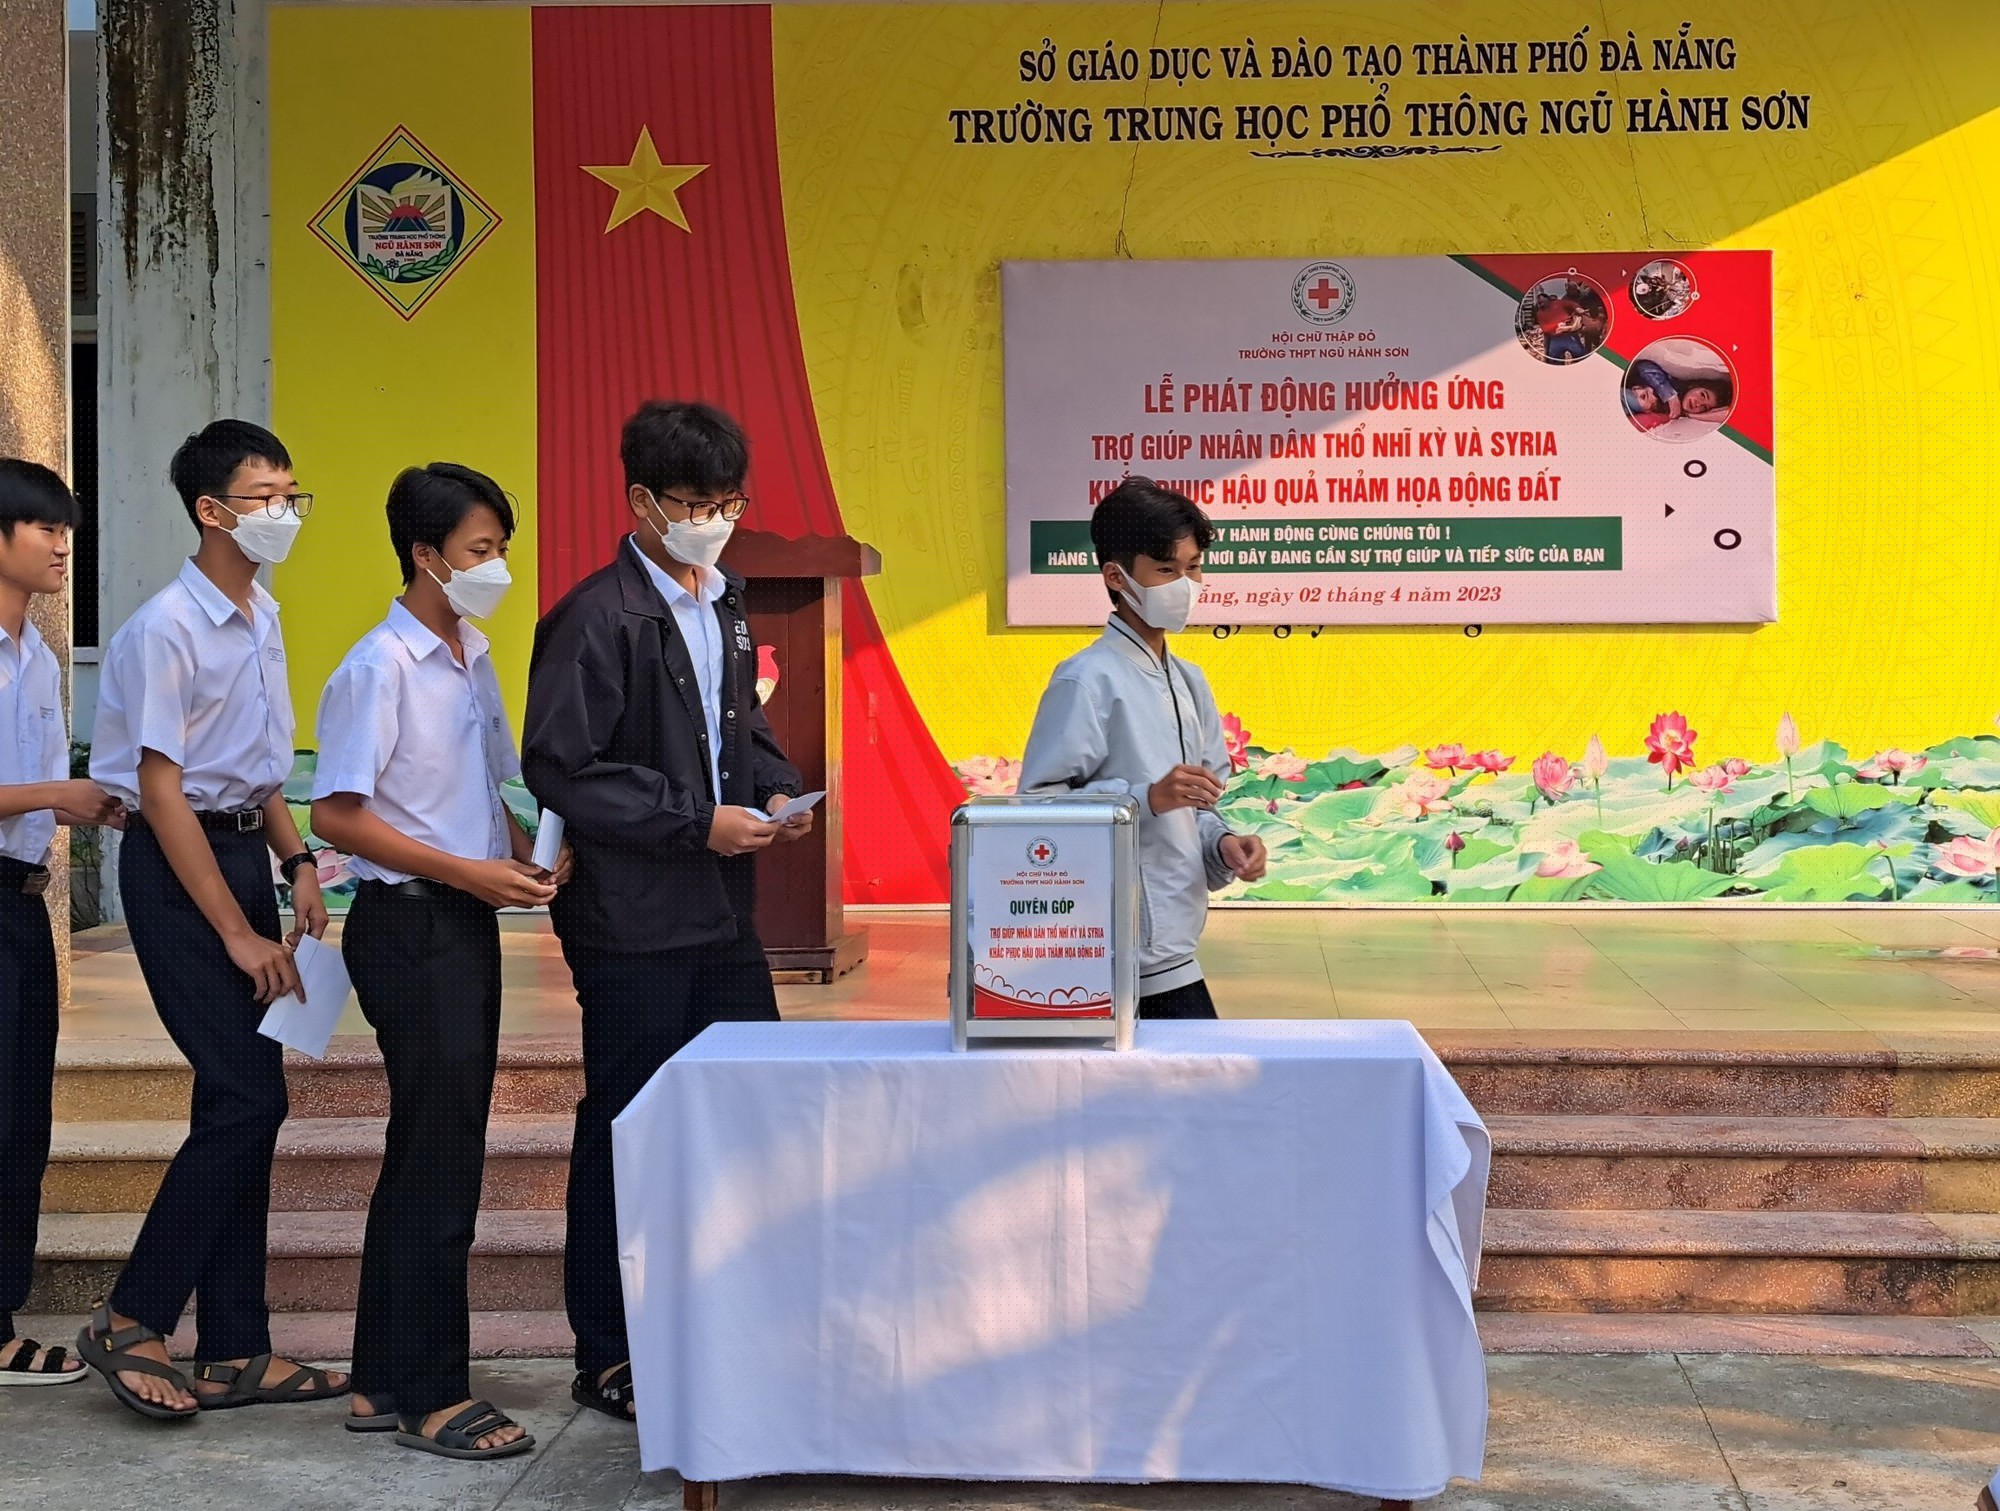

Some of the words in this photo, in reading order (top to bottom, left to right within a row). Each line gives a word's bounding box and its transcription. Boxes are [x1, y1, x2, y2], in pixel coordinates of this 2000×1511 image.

[1019, 38, 1057, 82] SỞ
[1068, 40, 1139, 81] GIÁO
[1149, 47, 1211, 87] DỤC
[1220, 37, 1262, 78] VÀ
[1271, 37, 1332, 78] ĐÀO
[1343, 44, 1402, 84] TẠO
[1412, 34, 1518, 75] THÀNH
[1528, 25, 1590, 74] PHỐ
[1600, 30, 1643, 72] ĐÀ
[1653, 22, 1737, 71] NẴNG
[949, 99, 1093, 144] TRƯỜNG
[1104, 106, 1224, 142] TRUNG
[1235, 104, 1309, 147] HỌC
[1321, 83, 1391, 139] PHỔ
[1404, 92, 1528, 137] THÔNG
[1540, 90, 1612, 135] NGŨ
[1626, 88, 1730, 133] HÀNH
[1741, 89, 1811, 131] SƠN
[375, 240, 394, 250] NGŨ
[396, 240, 422, 250] HÀNH
[424, 240, 442, 249] SƠN
[1272, 331, 1293, 345] HỘI
[1297, 331, 1322, 342] CHỮ
[1325, 331, 1355, 345] THẬP
[1358, 329, 1376, 342] ĐỎ
[1239, 347, 1286, 359] TRƯỜNG
[1290, 349, 1316, 358] THPT
[1320, 346, 1345, 358] NGŨ
[1349, 346, 1381, 358] HÀNH
[1384, 347, 1409, 357] SƠN
[1144, 372, 1175, 413] LỄ
[1184, 376, 1252, 413] PHÁT
[1261, 376, 1335, 418] ĐỘNG
[1345, 372, 1438, 411] HƯỞNG
[1448, 377, 1504, 410] ỨNG
[1092, 433, 1134, 465] TRỢ
[1141, 429, 1192, 460] GIÚP
[1200, 429, 1262, 460] NHÂN
[1270, 428, 1316, 459] DÂN
[1323, 422, 1365, 458] THỔ
[1372, 428, 1411, 457] NHĨ
[1419, 426, 1447, 457] KỲ
[1454, 427, 1483, 457] VÀ
[1490, 431, 1557, 457] SYRIA
[1222, 474, 1266, 509] HẬU
[1274, 470, 1319, 506] QUẢ
[1326, 469, 1388, 503] THẢM
[1396, 476, 1441, 507] HỌA
[1449, 472, 1511, 507] ĐỘNG
[1518, 467, 1561, 502] ĐẤT
[1230, 525, 1270, 542] HÀNH
[1274, 525, 1314, 544] ĐỘNG
[1319, 523, 1358, 540] CÙNG
[1363, 523, 1413, 540] CHÚNG
[1417, 523, 1440, 539] TÔI
[1048, 549, 1087, 566] HÀNG
[1208, 549, 1234, 564] NƠI
[1239, 548, 1266, 565] ĐÂY
[1271, 551, 1311, 565] ĐANG
[1316, 546, 1346, 564] CẦN
[1351, 548, 1370, 566] SỰ
[1375, 548, 1402, 566] TRỢ
[1406, 545, 1441, 563] GIÚP
[1445, 545, 1464, 563] VÀ
[1468, 544, 1500, 563] TIẾP
[1505, 546, 1534, 562] SỨC
[1539, 544, 1569, 562] CỦA
[1573, 548, 1604, 565] BẠN
[1198, 584, 1239, 607] ẵng,
[1246, 587, 1293, 607] ngày
[1299, 586, 1321, 602] 02
[1327, 586, 1384, 605] tháng
[1390, 586, 1401, 602] 4
[1407, 588, 1450, 602] năm
[1456, 586, 1502, 602] 2023
[1010, 896, 1048, 916] QUYÊN
[1052, 896, 1075, 914] GÓP
